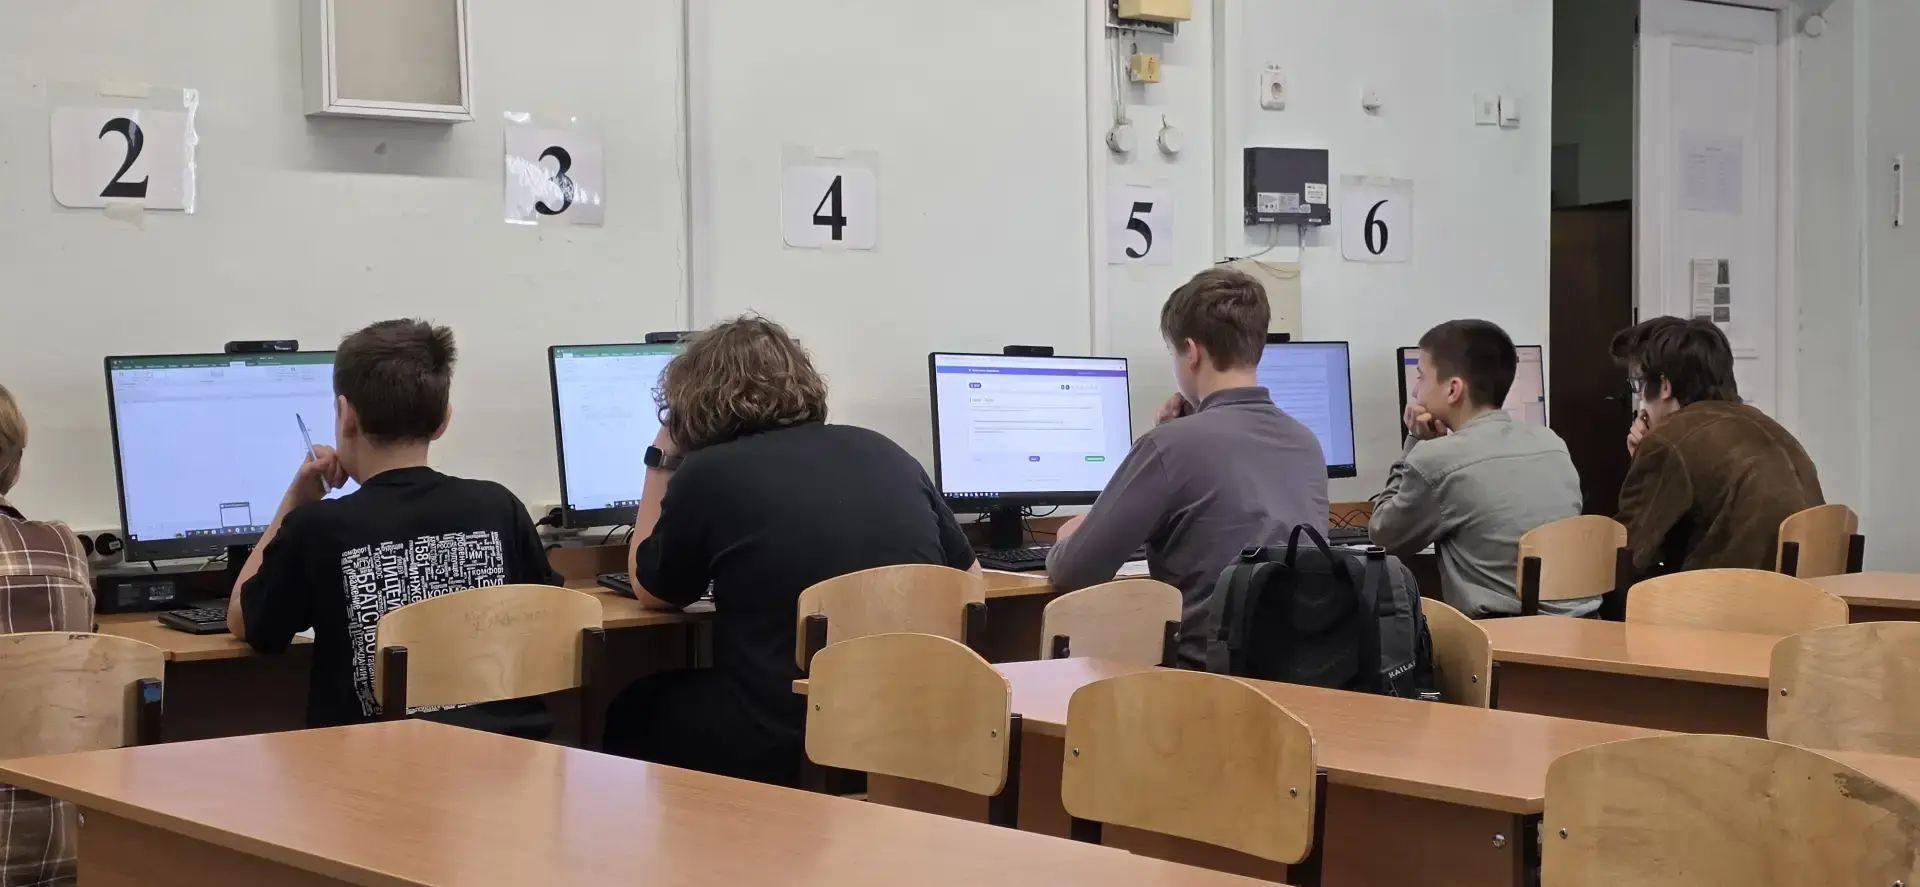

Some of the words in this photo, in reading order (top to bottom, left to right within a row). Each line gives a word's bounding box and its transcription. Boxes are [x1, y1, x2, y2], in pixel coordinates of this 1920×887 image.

[98, 117, 150, 198] 2
[534, 145, 574, 216] 3
[812, 174, 848, 241] 4
[1125, 201, 1154, 259] 5
[1364, 199, 1389, 256] 6
[415, 543, 430, 567] 1581
[455, 531, 466, 566] уровень
